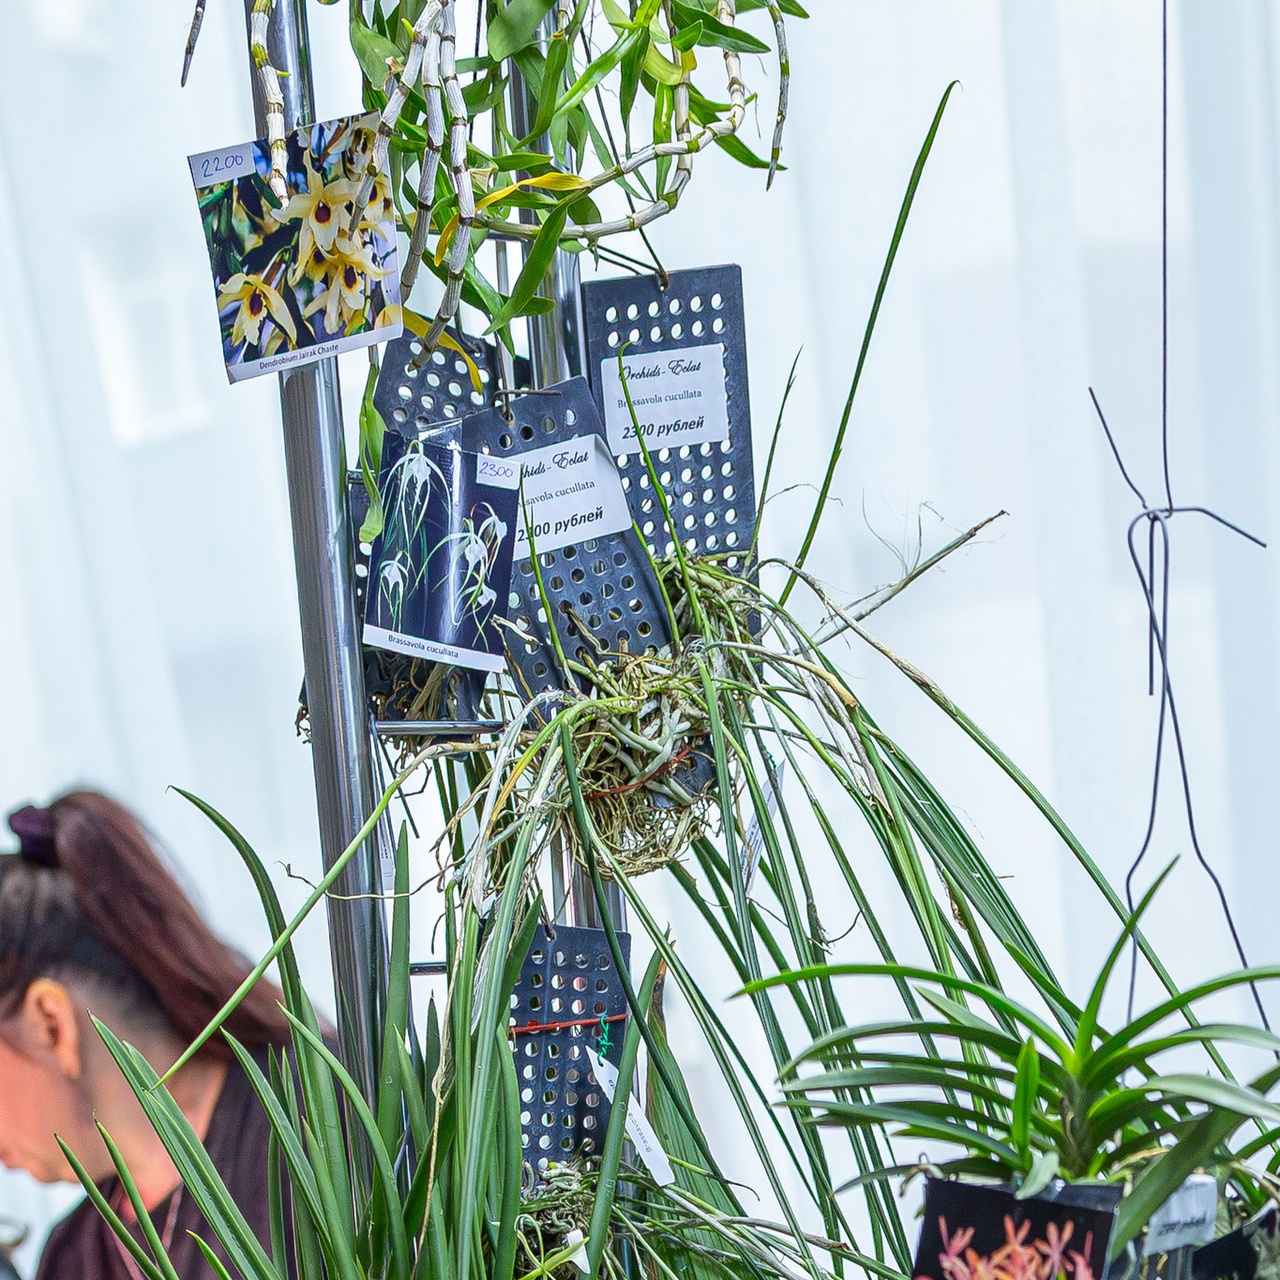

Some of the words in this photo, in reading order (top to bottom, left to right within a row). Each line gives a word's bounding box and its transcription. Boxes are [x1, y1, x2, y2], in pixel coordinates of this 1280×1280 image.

[201, 154, 244, 178] 2200
[259, 353, 299, 370] Dendrobium
[318, 343, 339, 357] Chaste
[617, 392, 663, 409] Brssavola
[664, 389, 702, 402] cucullata
[656, 415, 705, 438] рублей
[479, 461, 514, 478] 2300
[555, 480, 596, 498] cucullata
[517, 522, 551, 543] 200
[554, 506, 604, 535] рублей
[388, 635, 426, 651] Brassavola
[426, 645, 459, 658] cucullata
